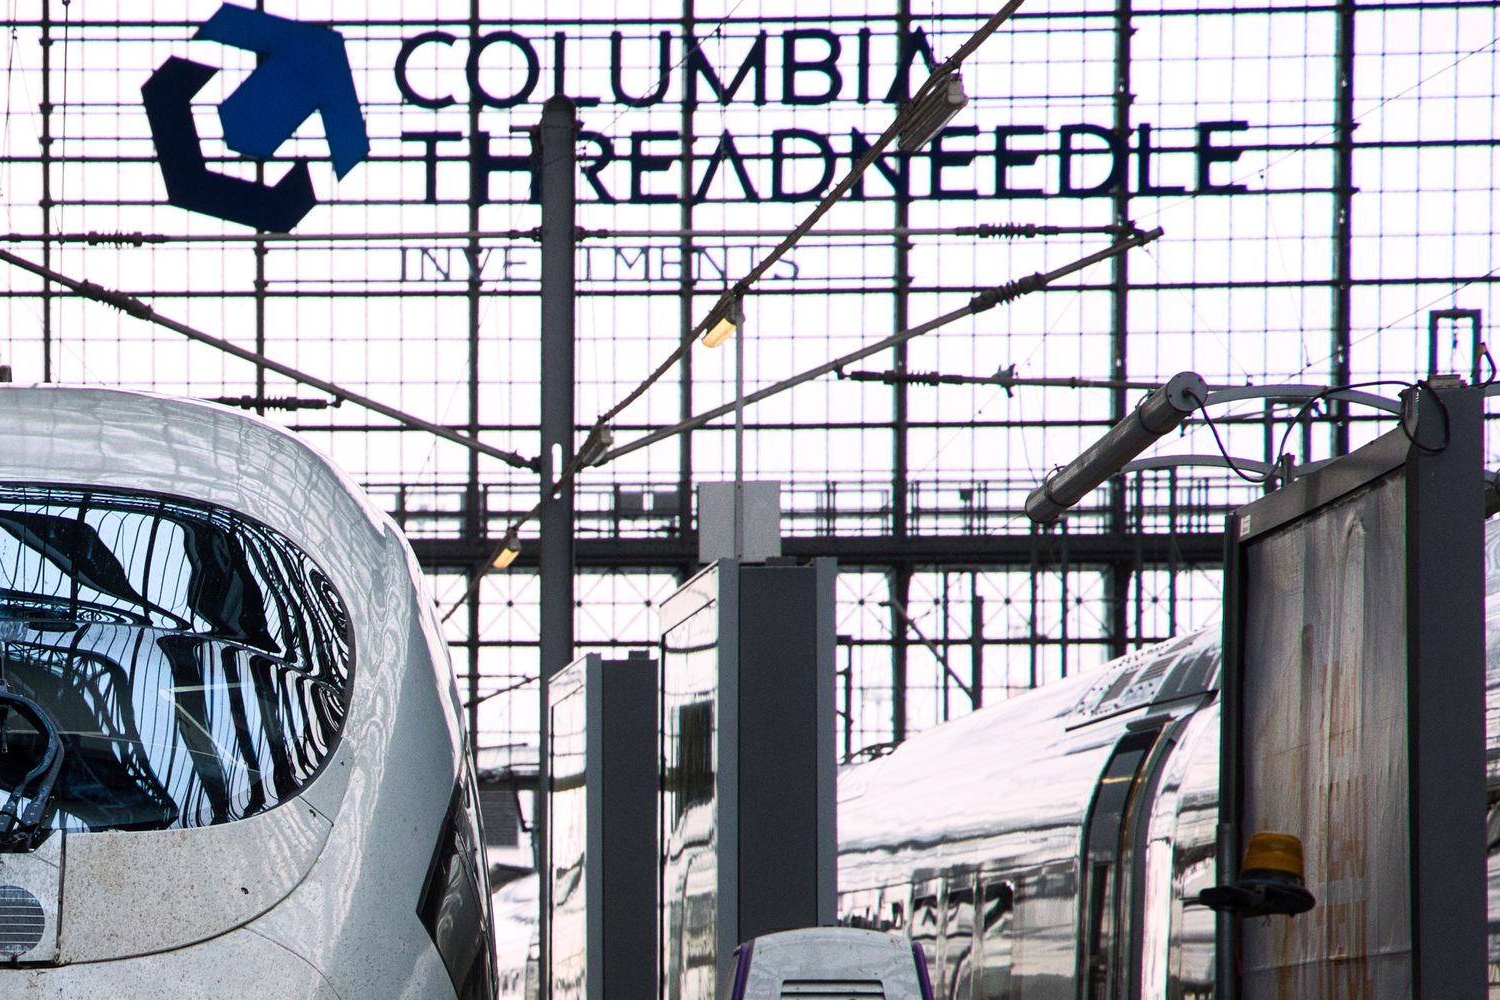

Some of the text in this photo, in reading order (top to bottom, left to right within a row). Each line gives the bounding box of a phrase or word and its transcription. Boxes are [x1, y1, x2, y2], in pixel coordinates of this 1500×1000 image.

[395, 26, 941, 108] COLUMBIA
[401, 121, 1248, 204] THREADNEEDLE
[401, 246, 799, 281] INVETMENTS
